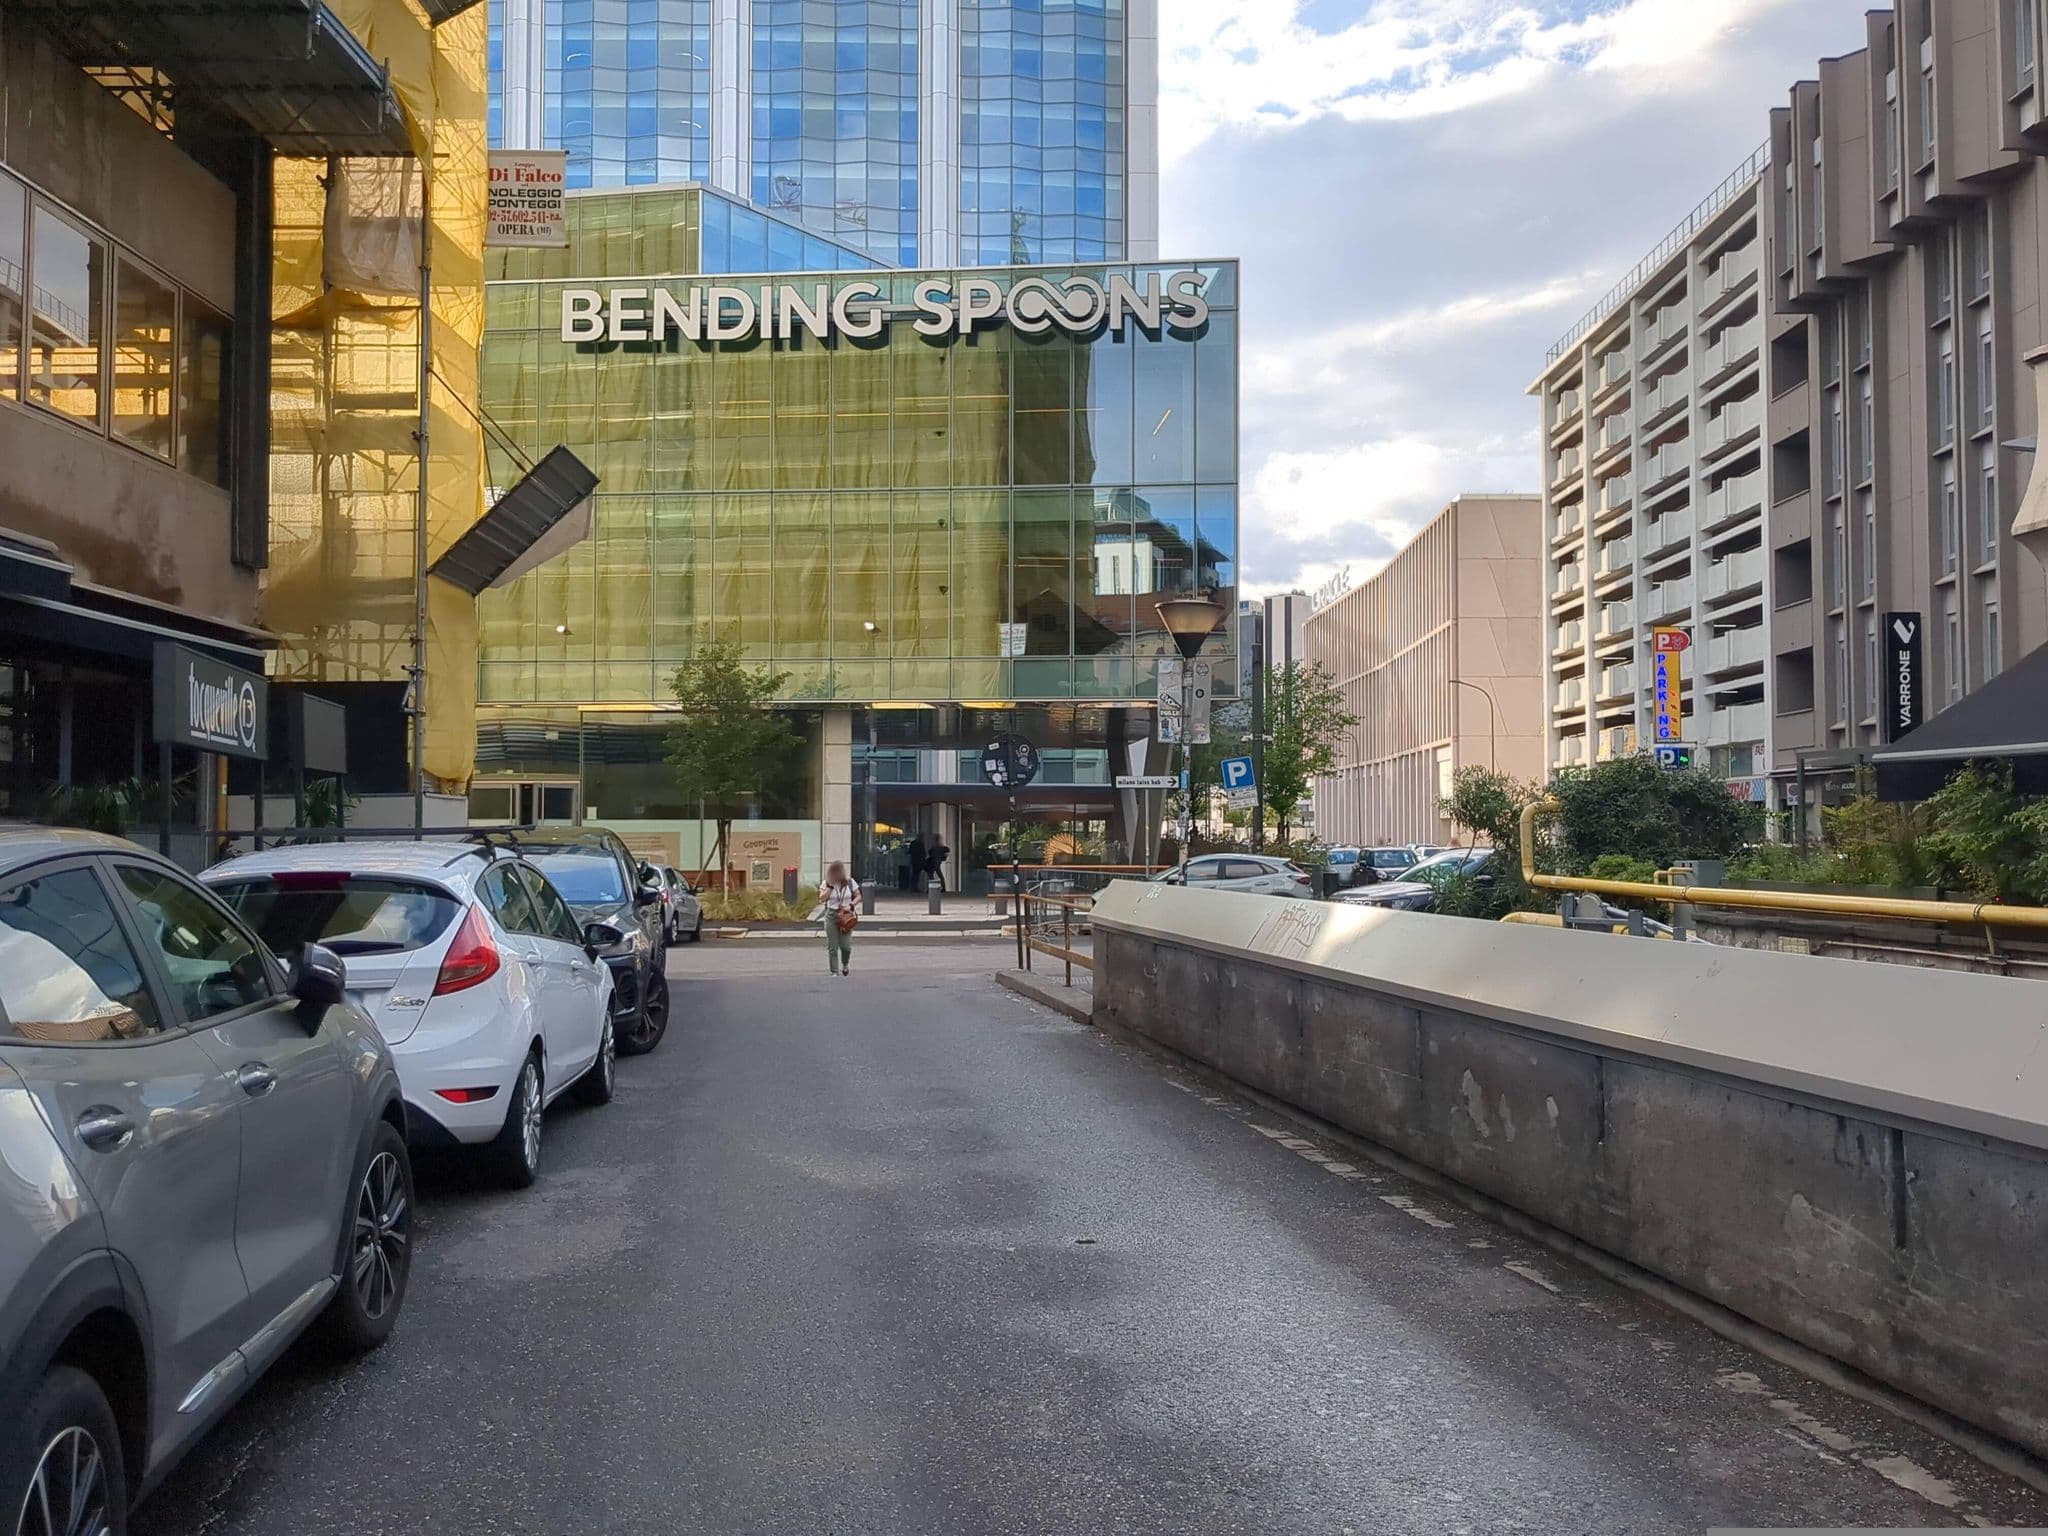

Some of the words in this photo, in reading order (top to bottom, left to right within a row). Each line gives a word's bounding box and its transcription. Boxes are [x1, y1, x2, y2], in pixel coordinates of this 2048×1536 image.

[488, 168, 509, 182] Di
[515, 168, 562, 183] Falco
[488, 188, 562, 198] NOLEGGIO
[488, 199, 561, 209] PONTEGGI
[497, 224, 535, 236] OPERA
[560, 282, 884, 343] BENDING
[912, 270, 1210, 336] SPOONS
[1657, 634, 1671, 650] P
[1657, 654, 1670, 738] PARKING
[1899, 650, 1912, 728] VARRONE
[188, 661, 239, 741] tocqueville
[241, 698, 254, 728] 13
[1660, 749, 1676, 769] P
[1227, 761, 1247, 786] P
